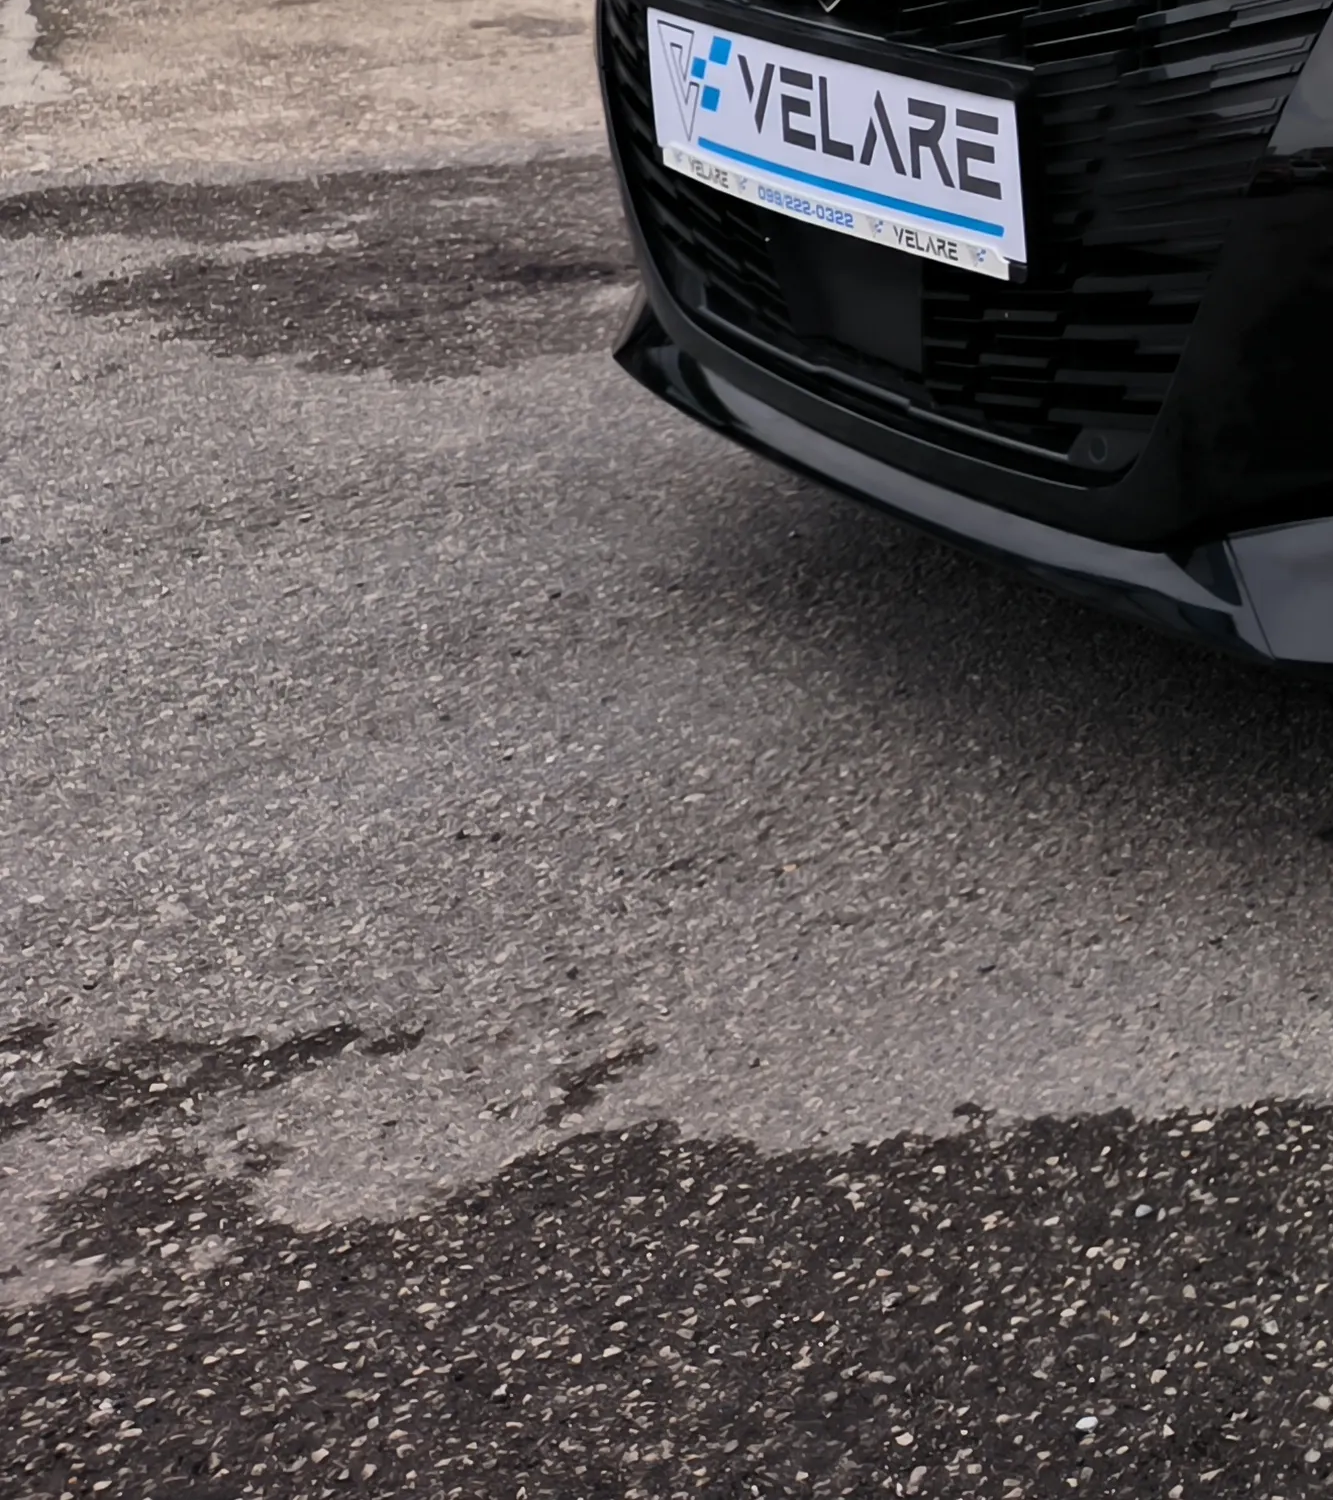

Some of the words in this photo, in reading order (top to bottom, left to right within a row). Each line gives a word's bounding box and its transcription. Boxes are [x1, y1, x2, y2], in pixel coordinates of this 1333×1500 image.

[738, 54, 1002, 200] VELARE
[687, 155, 729, 190] VELARE
[757, 184, 854, 229] 099/222-0322
[893, 225, 959, 262] VELARE
